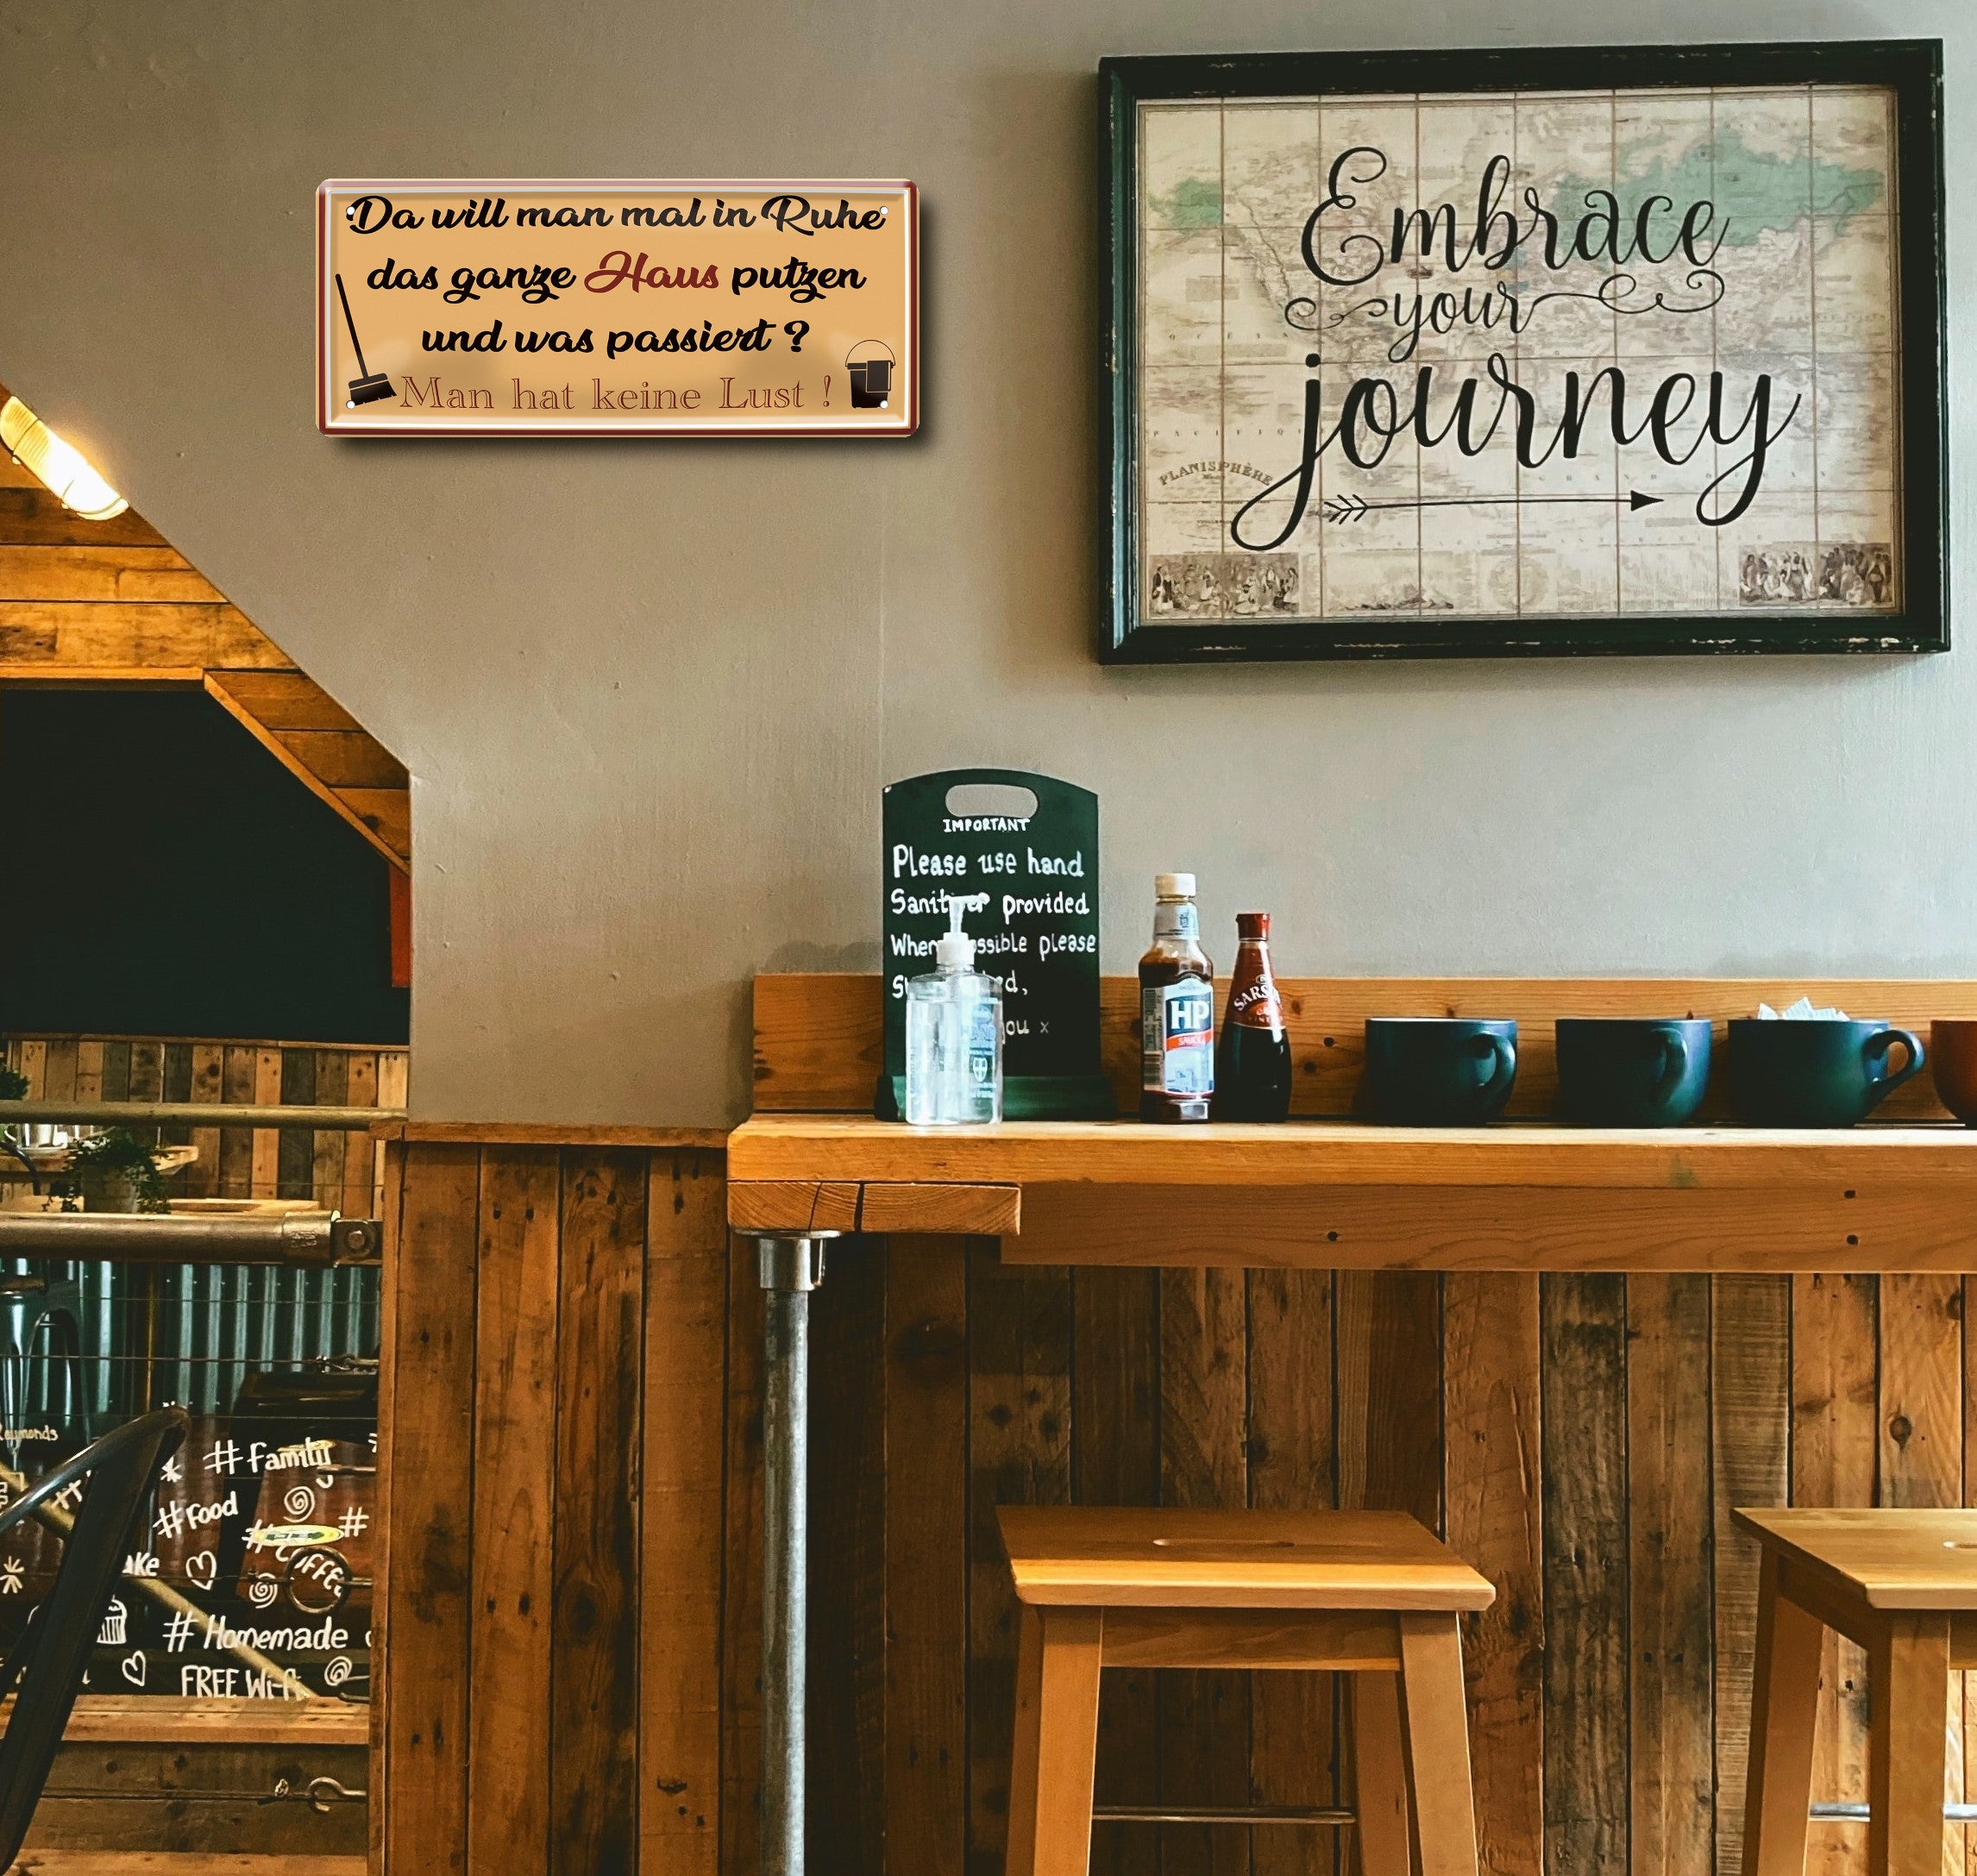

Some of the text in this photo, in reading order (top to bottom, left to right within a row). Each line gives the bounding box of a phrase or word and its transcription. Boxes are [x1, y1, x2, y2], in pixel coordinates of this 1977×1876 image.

[346, 195, 887, 236] Da will man mal in Ruhe
[1302, 147, 1729, 286] Embrace
[367, 250, 868, 304] das ganze Haus putzen
[422, 319, 508, 353] und
[514, 328, 594, 354] was
[606, 318, 778, 361] passiert
[399, 376, 494, 410] Man
[512, 377, 576, 411] hat
[591, 378, 701, 411] keine
[718, 377, 806, 409] Lust
[1231, 353, 1802, 552] journey
[943, 817, 1031, 834] IMPORTANT
[893, 844, 1085, 878] Please use hand
[1002, 890, 1090, 925] provided
[1039, 932, 1096, 962] please
[1170, 1000, 1210, 1030] HP
[180, 1664, 240, 1699] FREE
